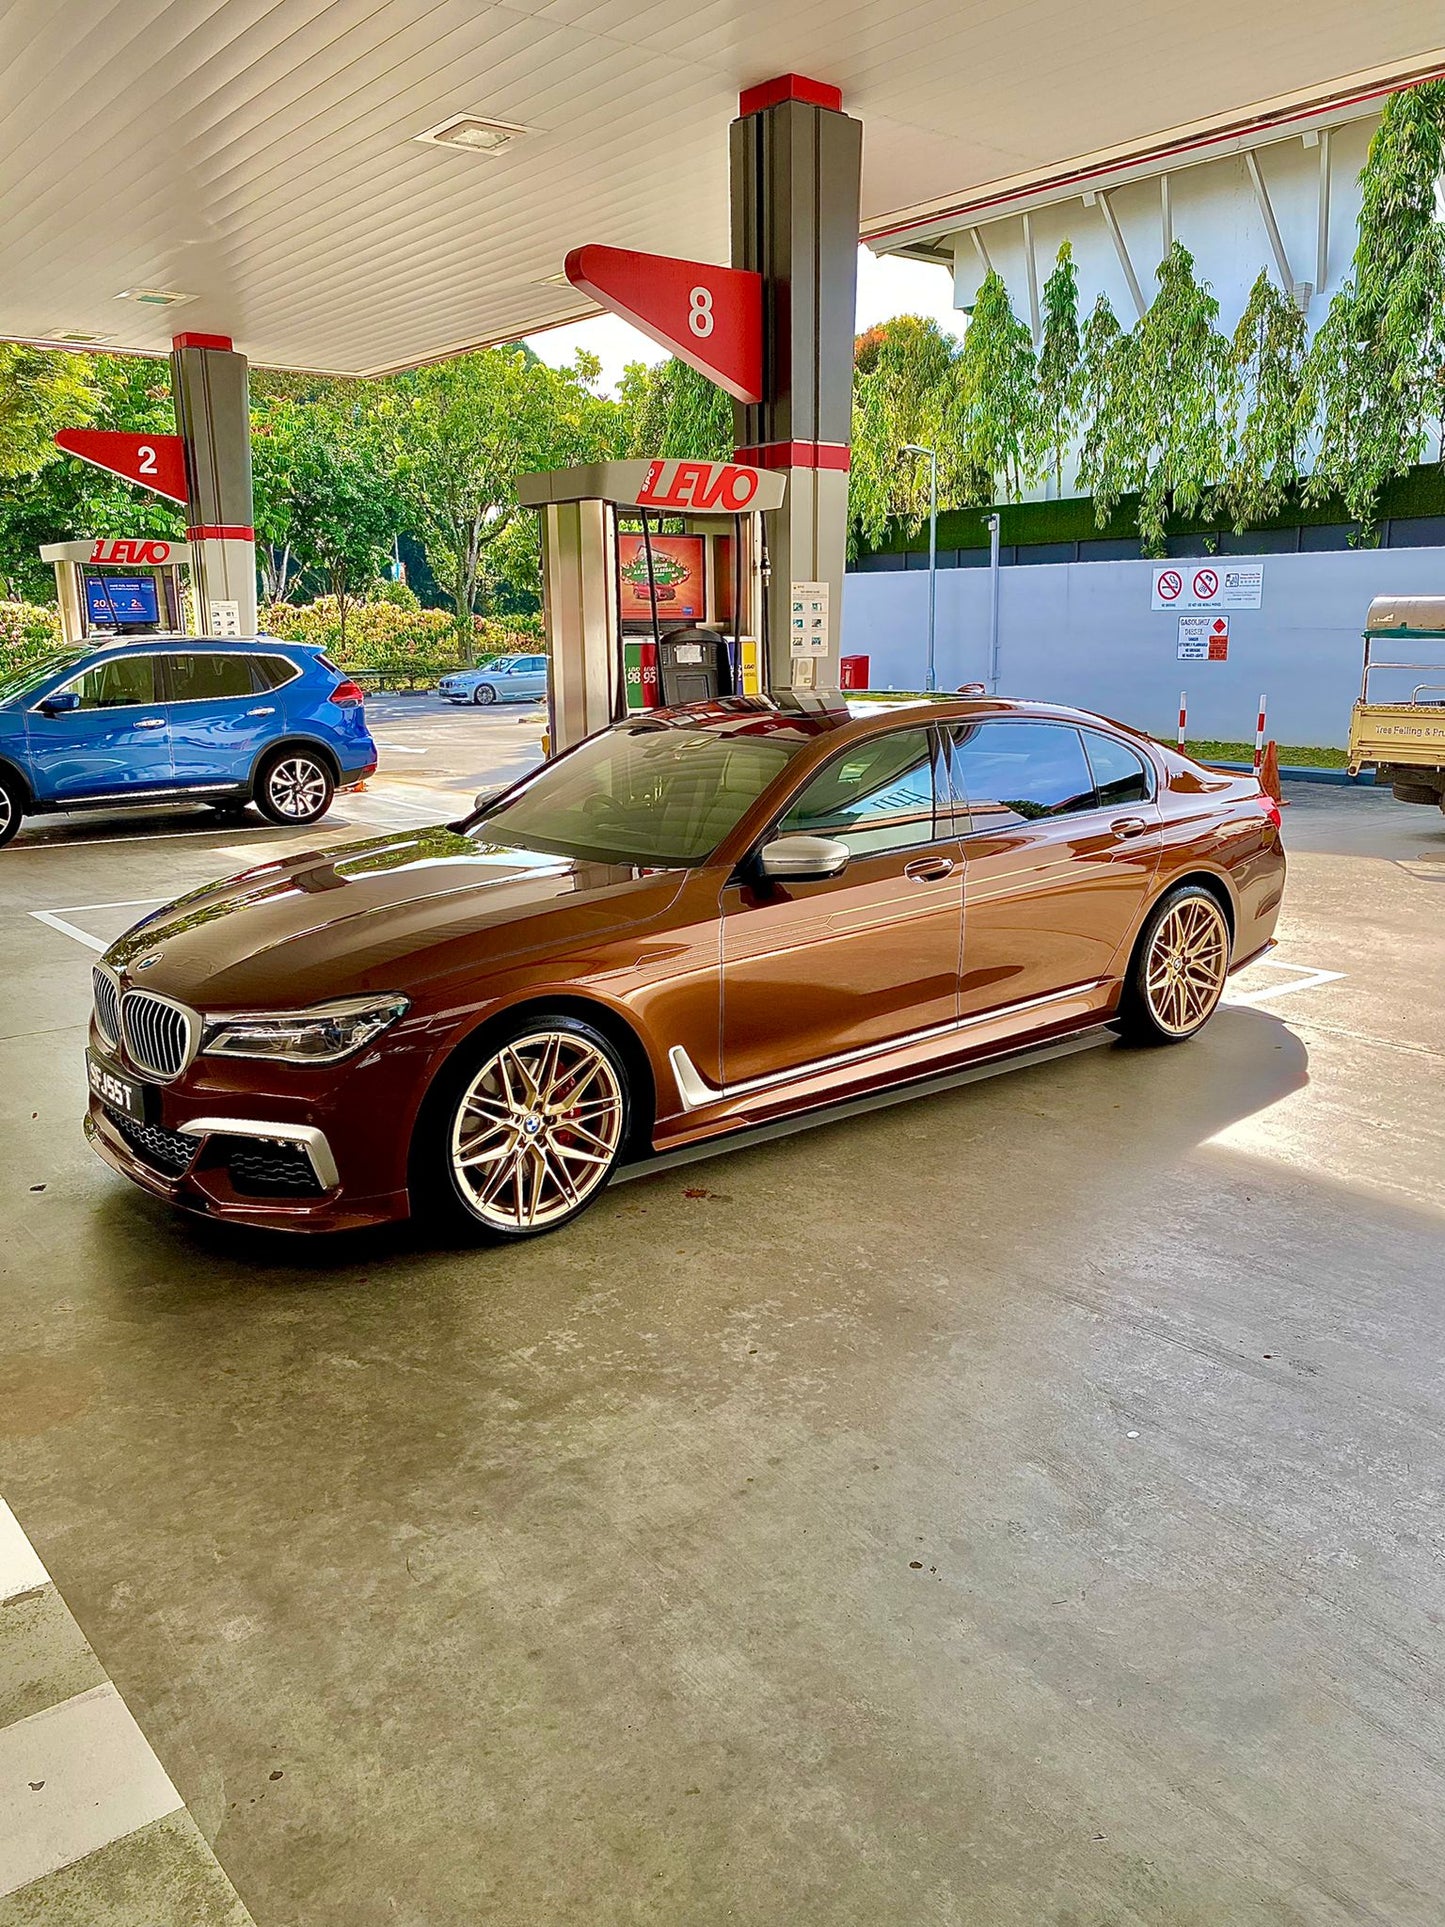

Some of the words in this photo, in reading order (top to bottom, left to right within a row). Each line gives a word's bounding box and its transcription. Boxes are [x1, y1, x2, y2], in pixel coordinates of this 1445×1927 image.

[689, 286, 714, 338] 8
[138, 446, 157, 474] 2
[635, 461, 759, 511] LEVO
[90, 540, 170, 564] LEVO
[628, 671, 641, 684] 98
[643, 671, 656, 684] 95
[1376, 725, 1392, 734] Tree
[1394, 726, 1422, 737] Felling
[1425, 728, 1431, 736] &
[90, 1062, 132, 1110] SFJ55T
